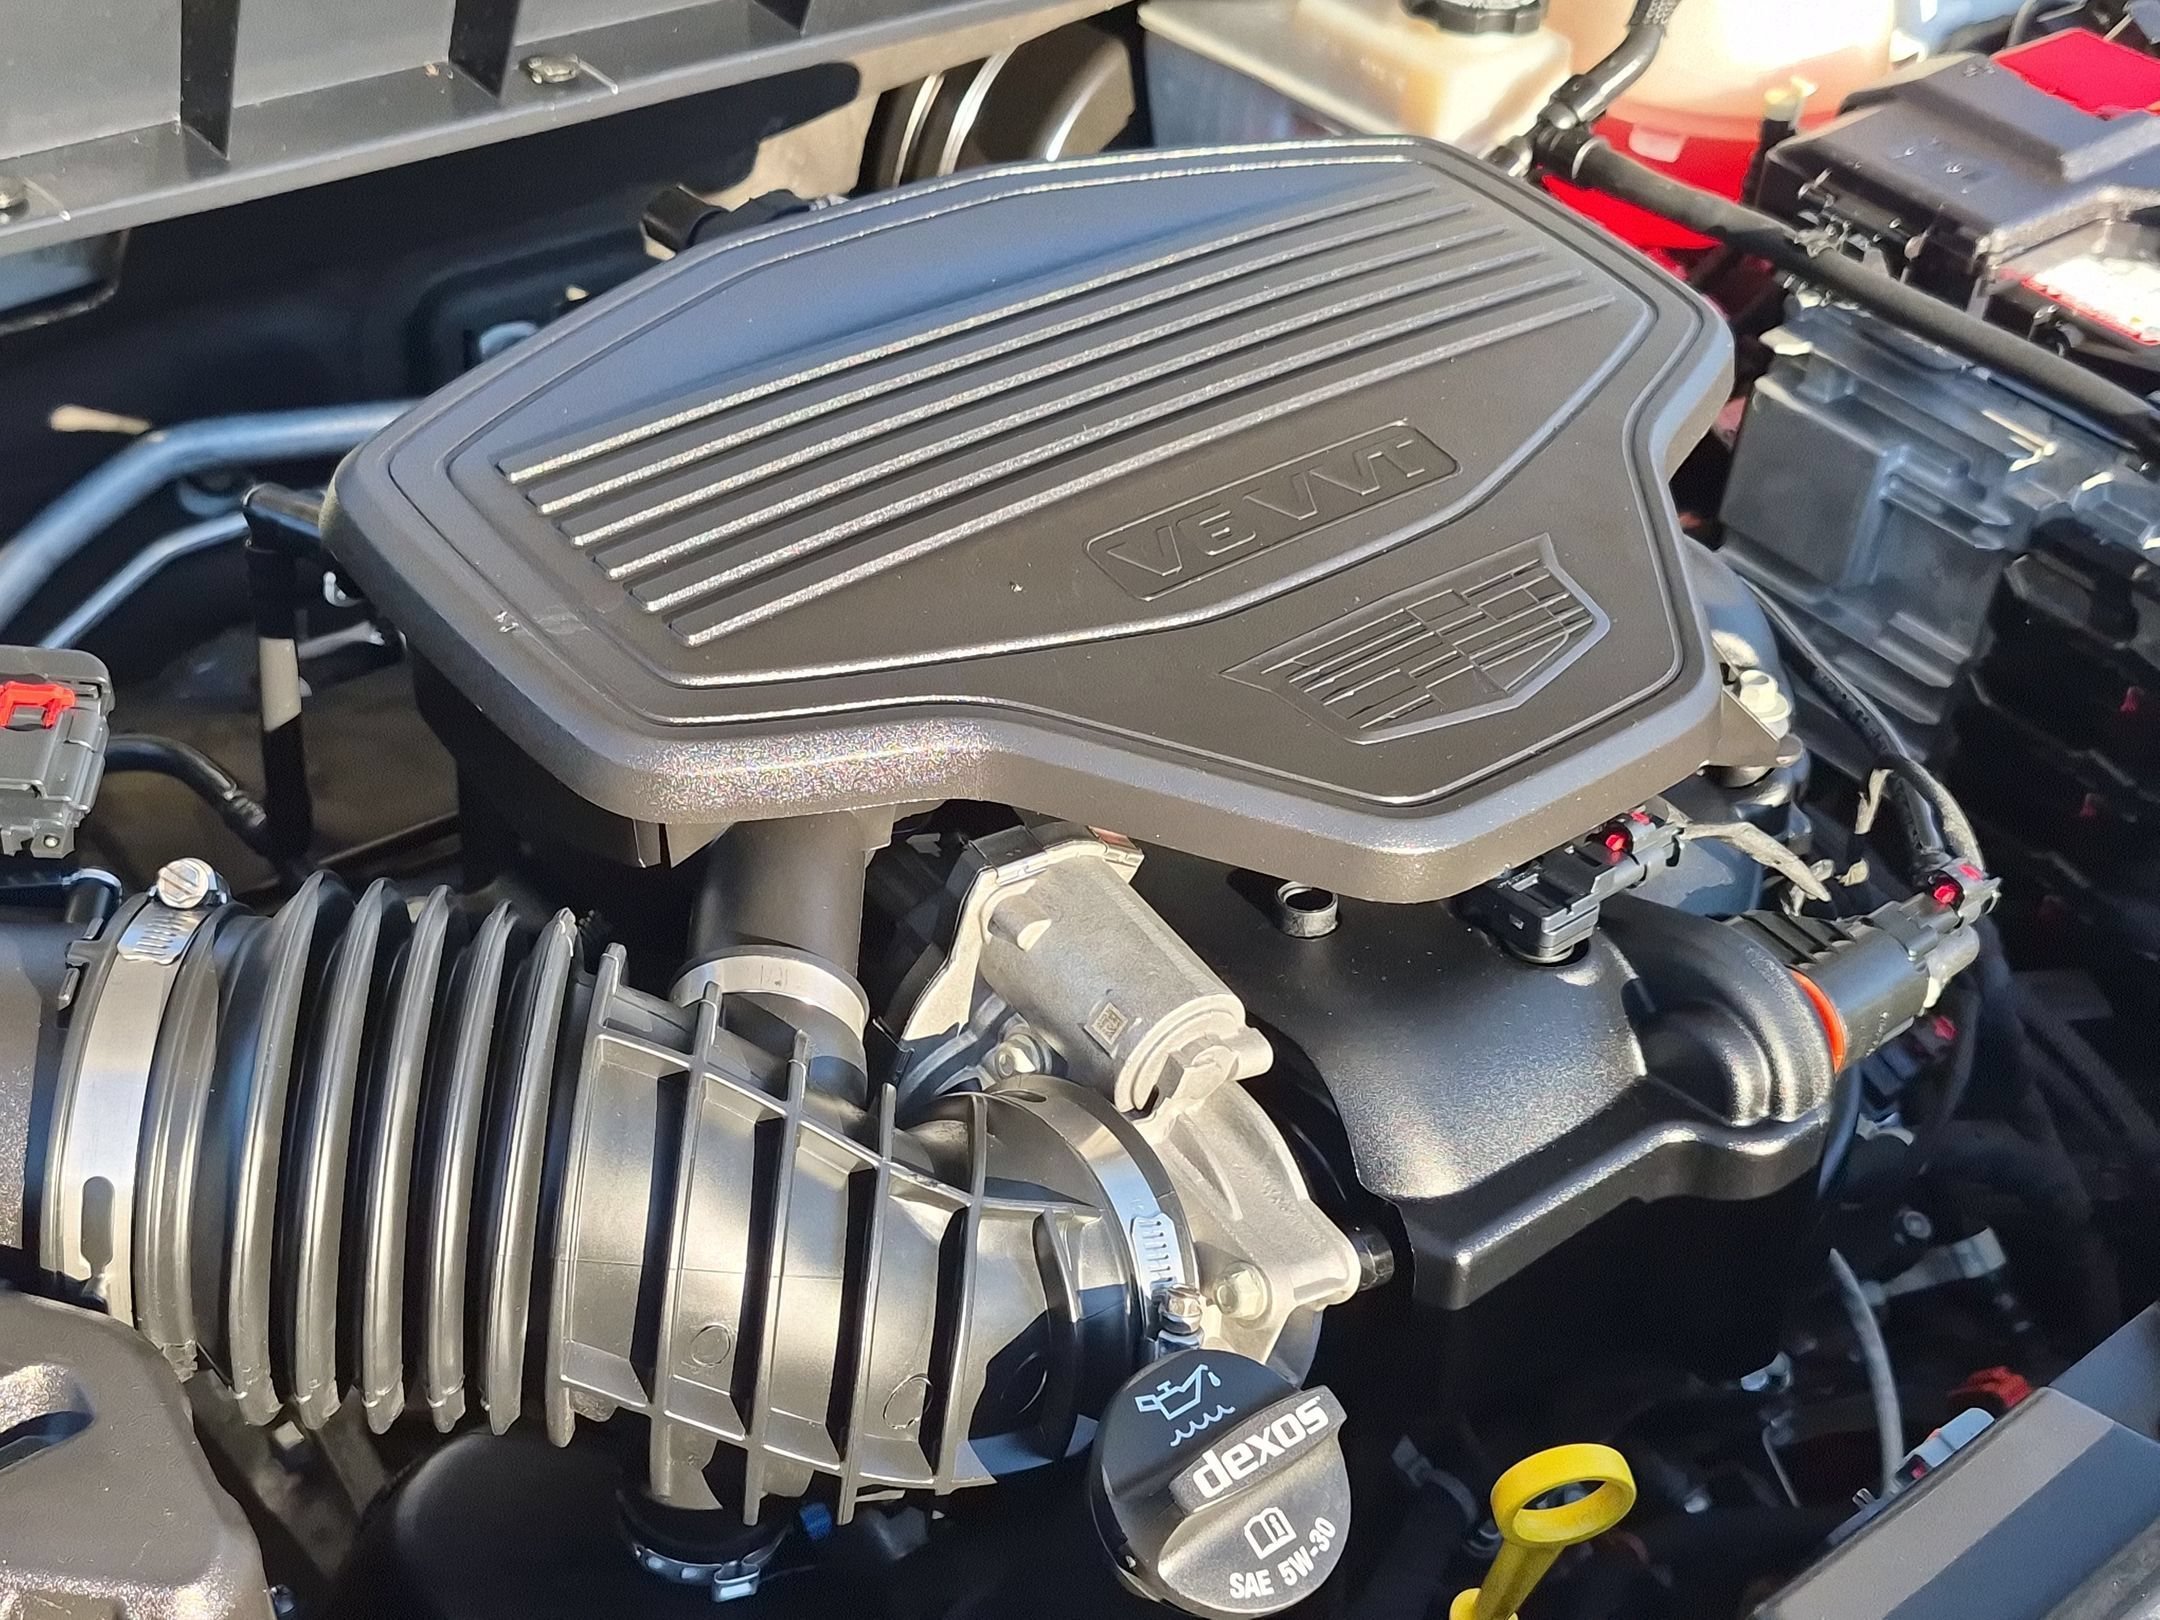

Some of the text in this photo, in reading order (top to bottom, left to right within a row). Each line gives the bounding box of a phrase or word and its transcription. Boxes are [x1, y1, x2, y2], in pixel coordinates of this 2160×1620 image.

[1192, 1395, 1329, 1499] dexos
[1229, 1516, 1336, 1599] SAE 5W-30
